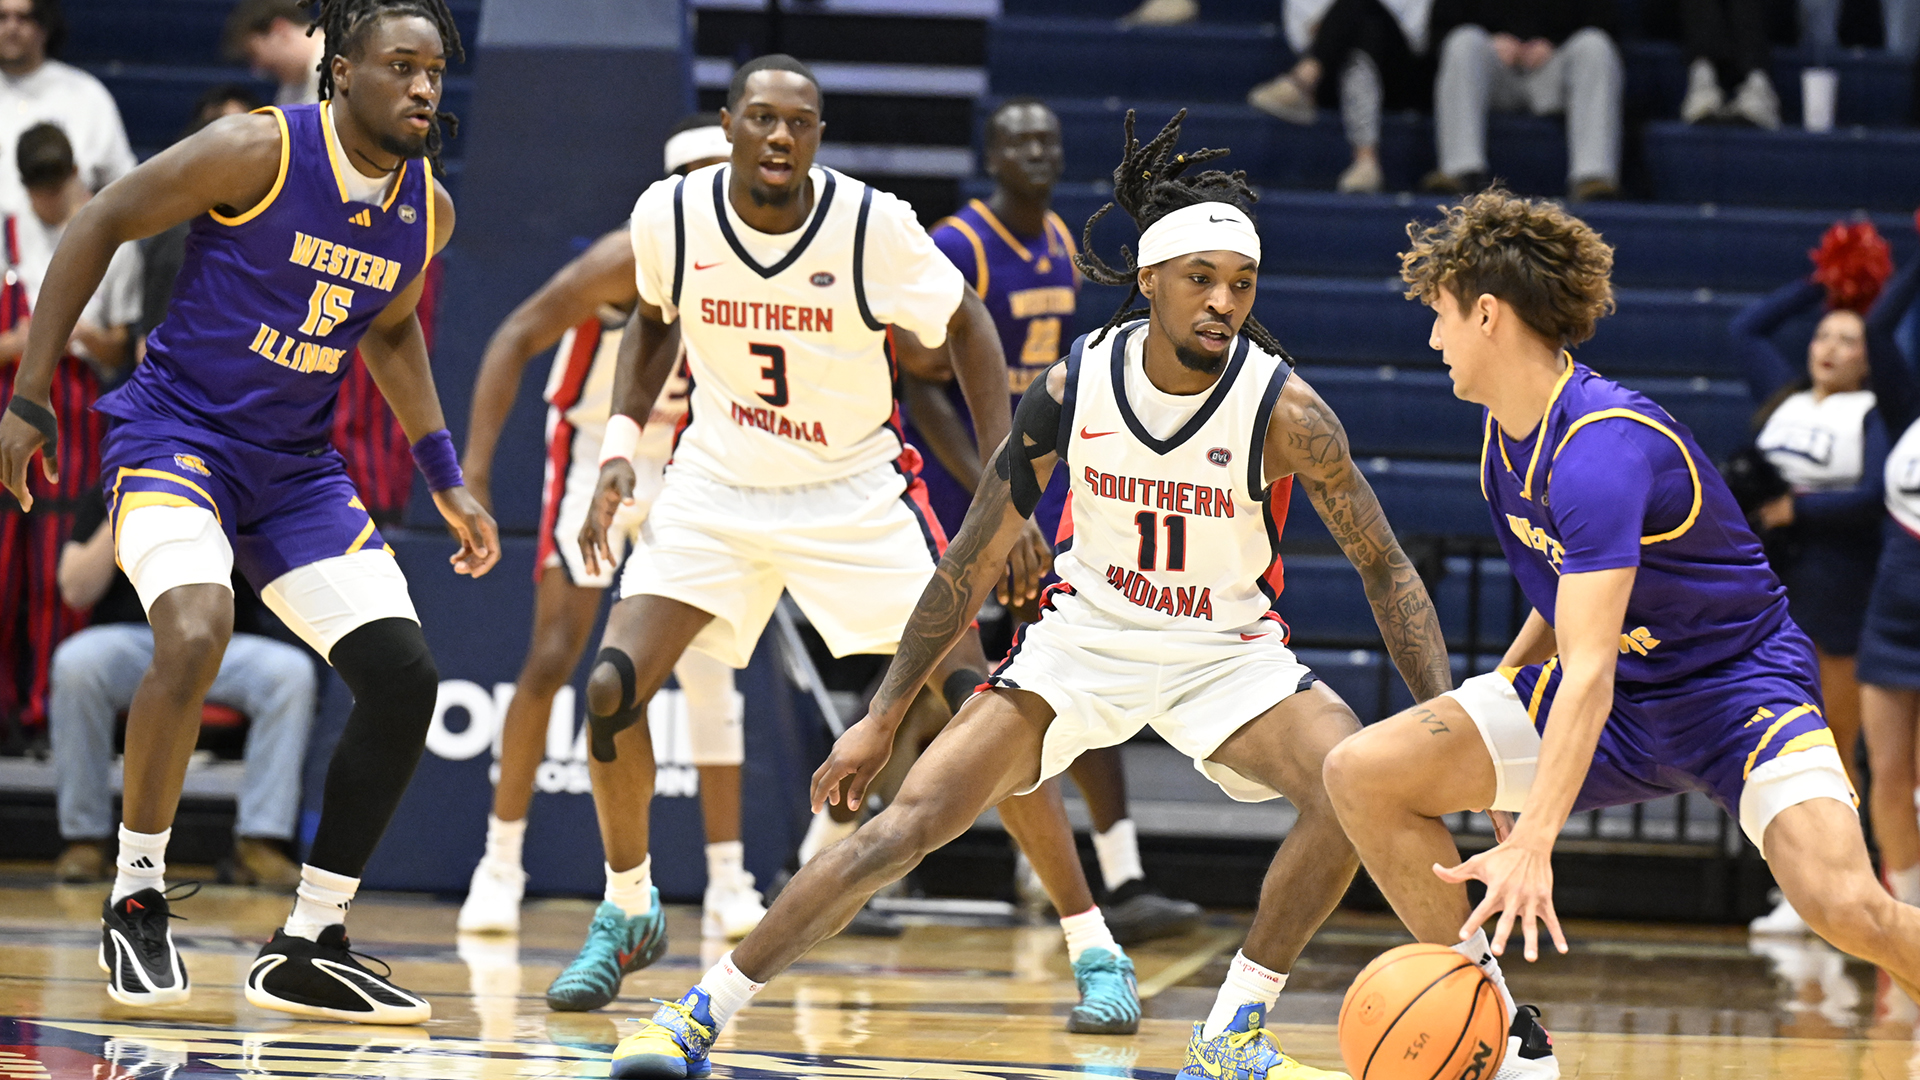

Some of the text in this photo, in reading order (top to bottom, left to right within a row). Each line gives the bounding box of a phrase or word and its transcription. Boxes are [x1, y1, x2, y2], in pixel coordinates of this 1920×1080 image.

[289, 231, 401, 292] WESTERN
[298, 280, 355, 337] 15
[701, 298, 833, 332] SOUTHERN
[748, 341, 789, 408] 3
[1084, 466, 1235, 518] SOUTHERN
[1134, 510, 1186, 572] 11
[1106, 564, 1213, 621] INDIANA
